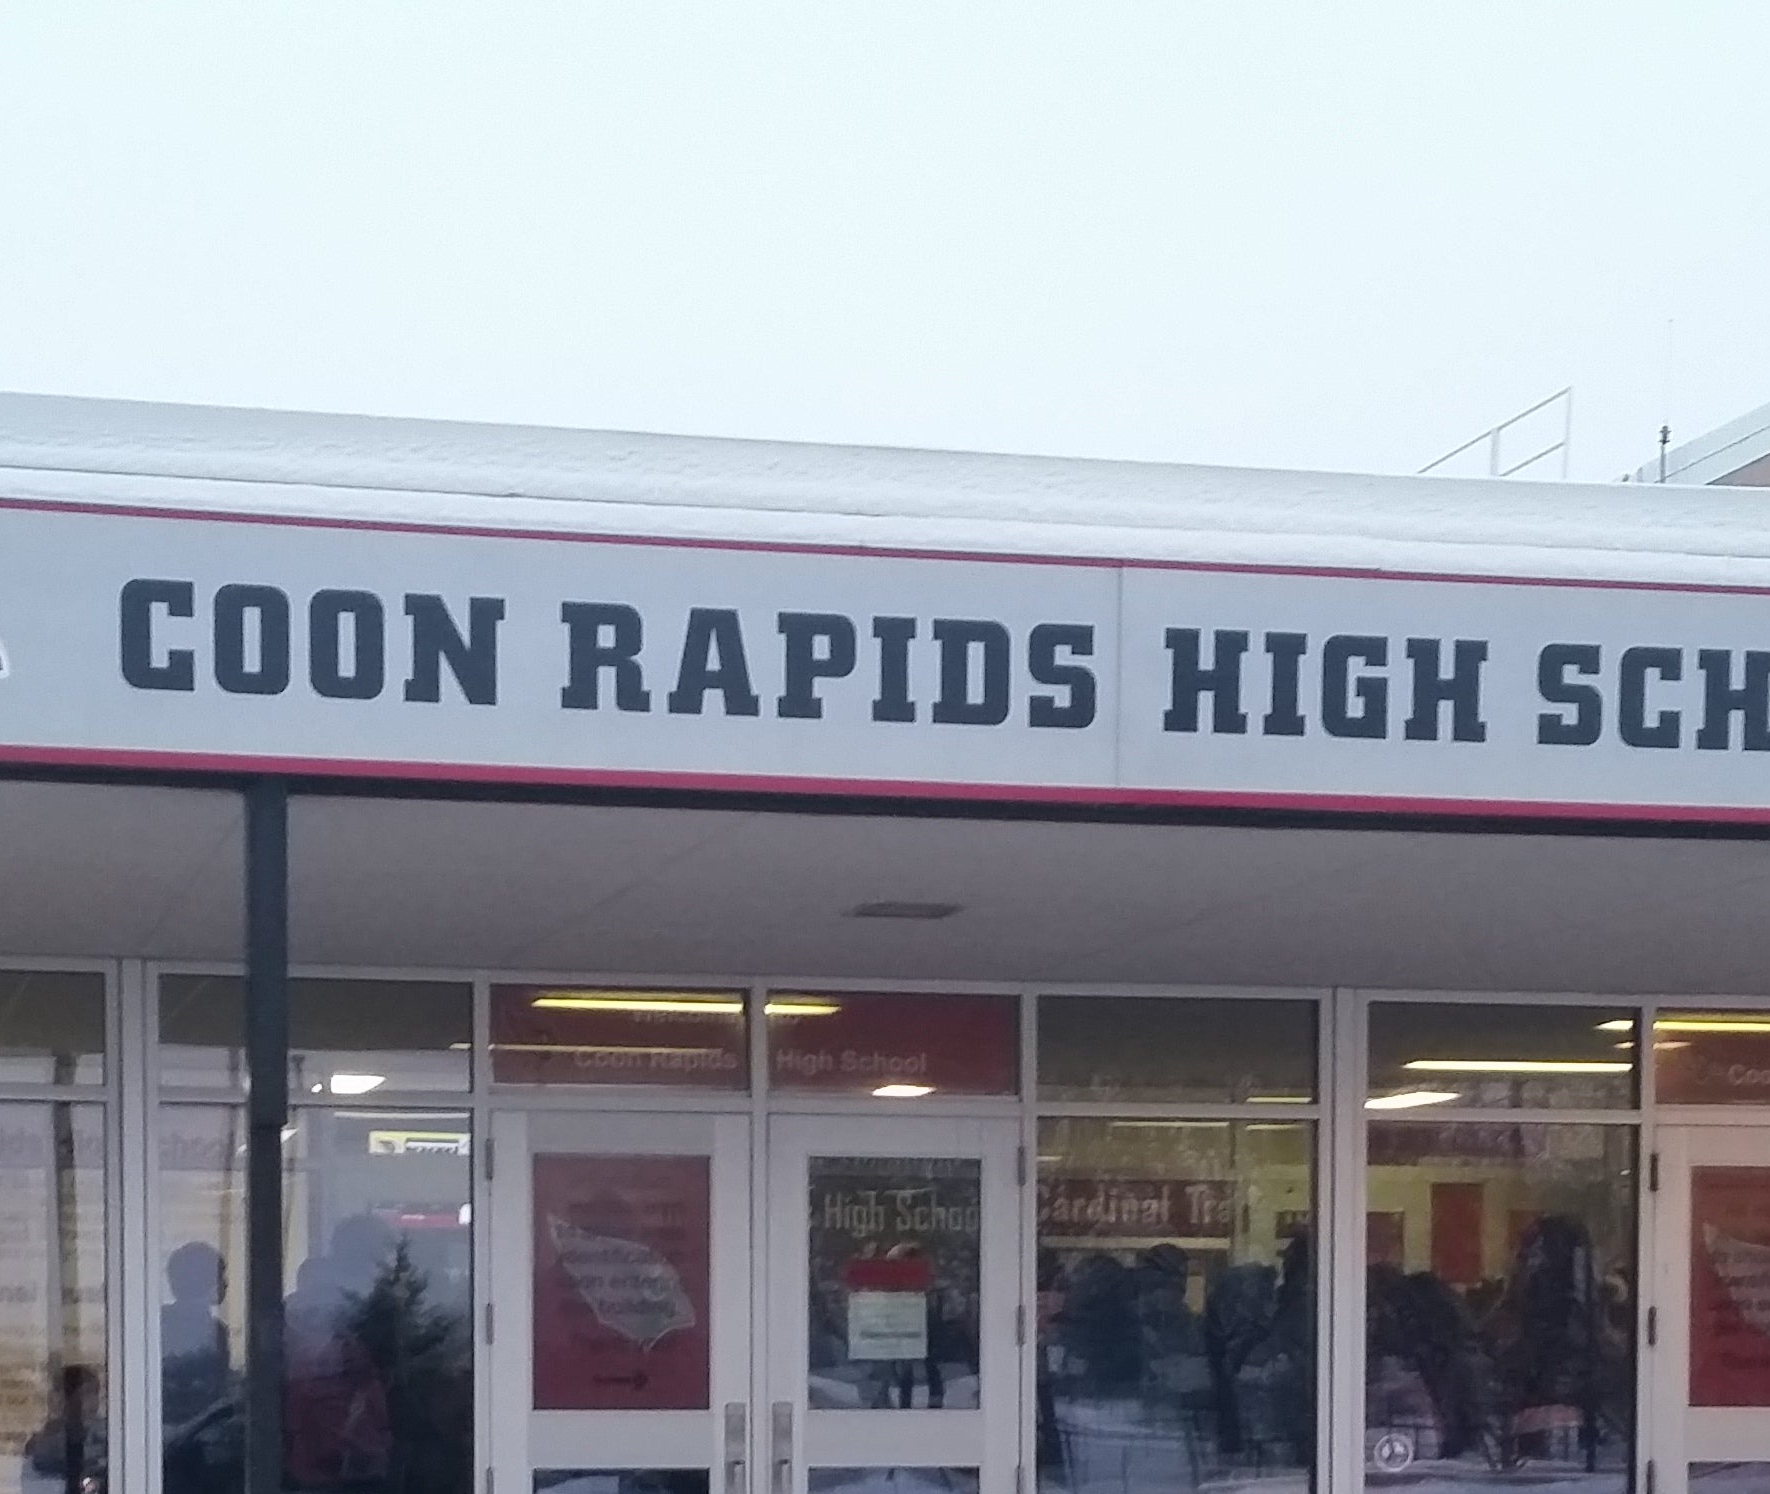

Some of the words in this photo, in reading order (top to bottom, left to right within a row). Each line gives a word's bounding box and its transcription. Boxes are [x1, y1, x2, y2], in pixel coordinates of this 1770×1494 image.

[119, 577, 506, 706] COON
[559, 600, 1098, 730] RAPIDS
[1161, 625, 1489, 744] HIGH
[776, 1047, 832, 1076] High
[839, 1050, 929, 1074] School
[824, 1189, 886, 1239] High
[894, 1192, 980, 1232] Schoo
[1036, 1182, 1171, 1224] Cardinal
